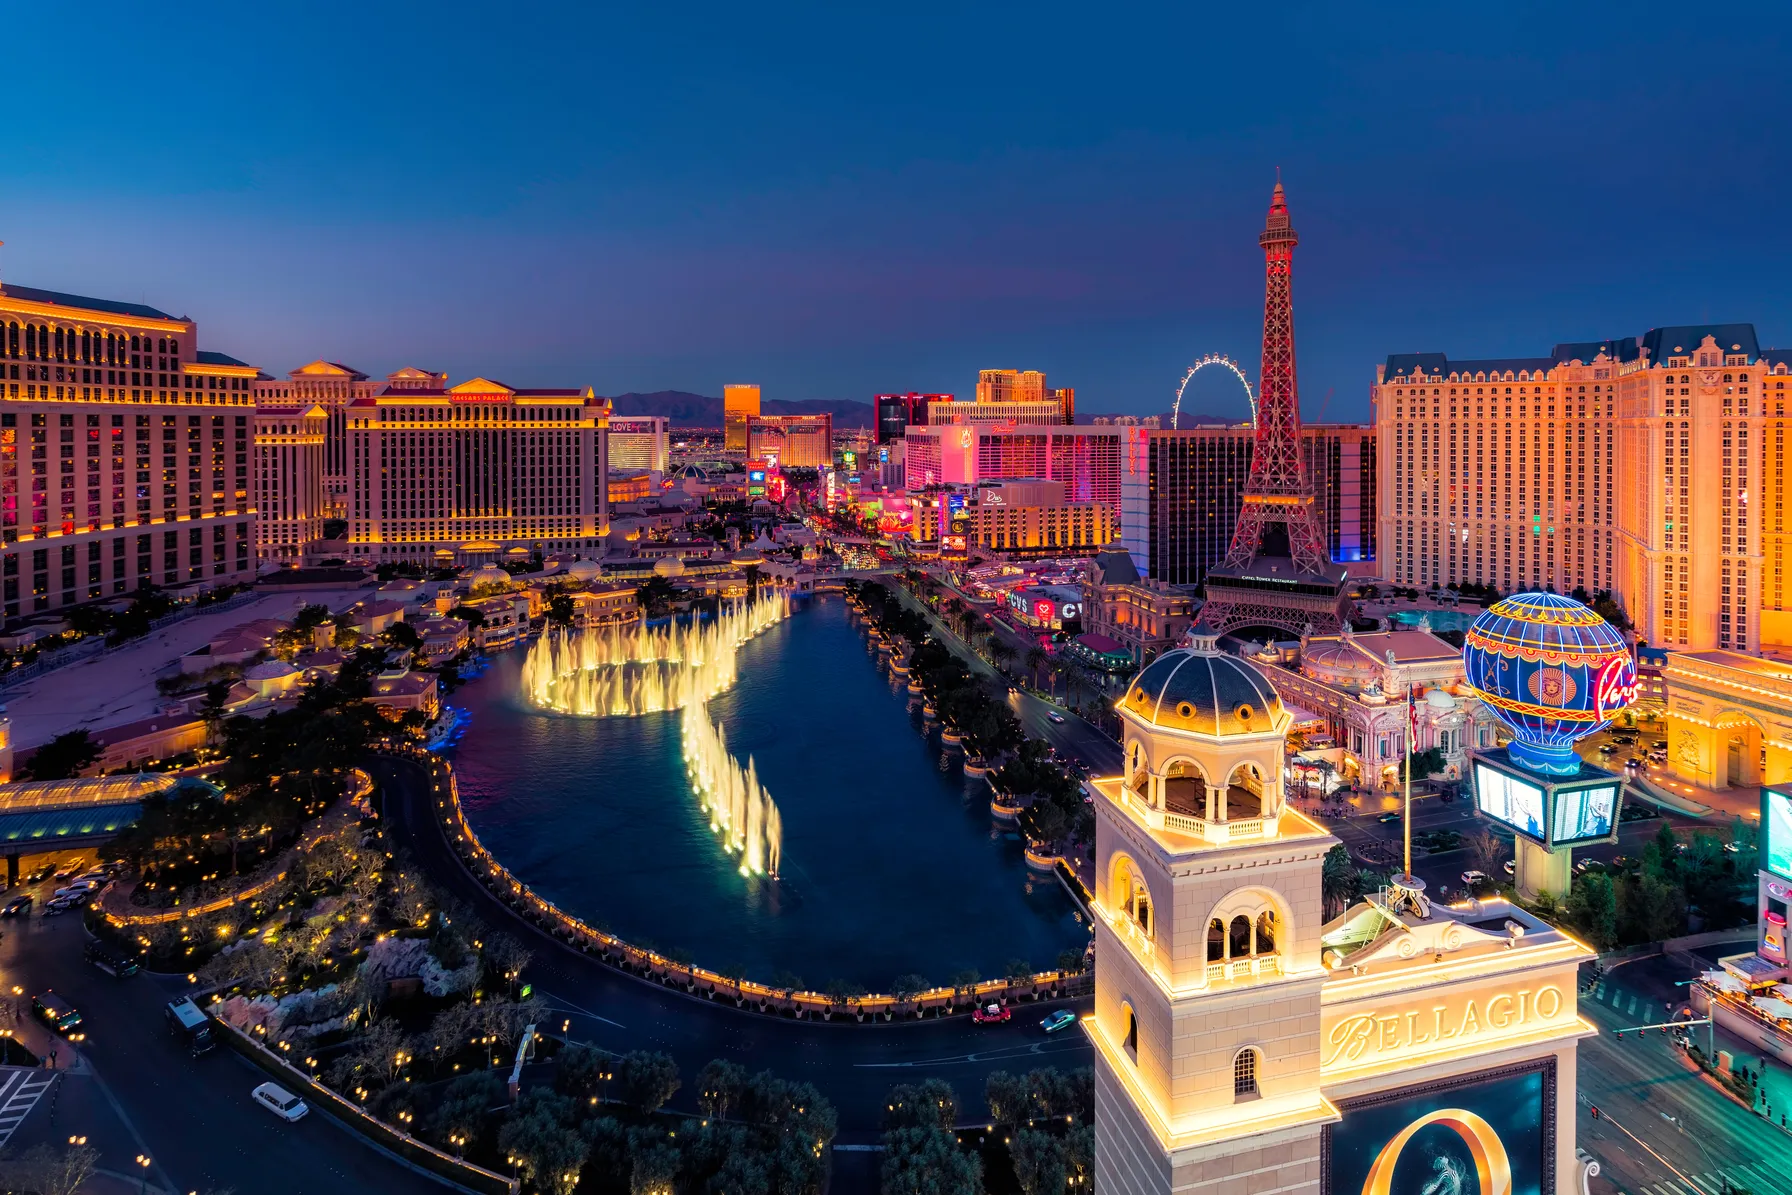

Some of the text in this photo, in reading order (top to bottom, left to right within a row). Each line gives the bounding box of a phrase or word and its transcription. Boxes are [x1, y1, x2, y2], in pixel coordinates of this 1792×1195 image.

[613, 422, 632, 432] LOVE
[1010, 592, 1028, 613] CVS
[1597, 657, 1643, 722] Paris
[1320, 985, 1563, 1066] BELLAGIO
